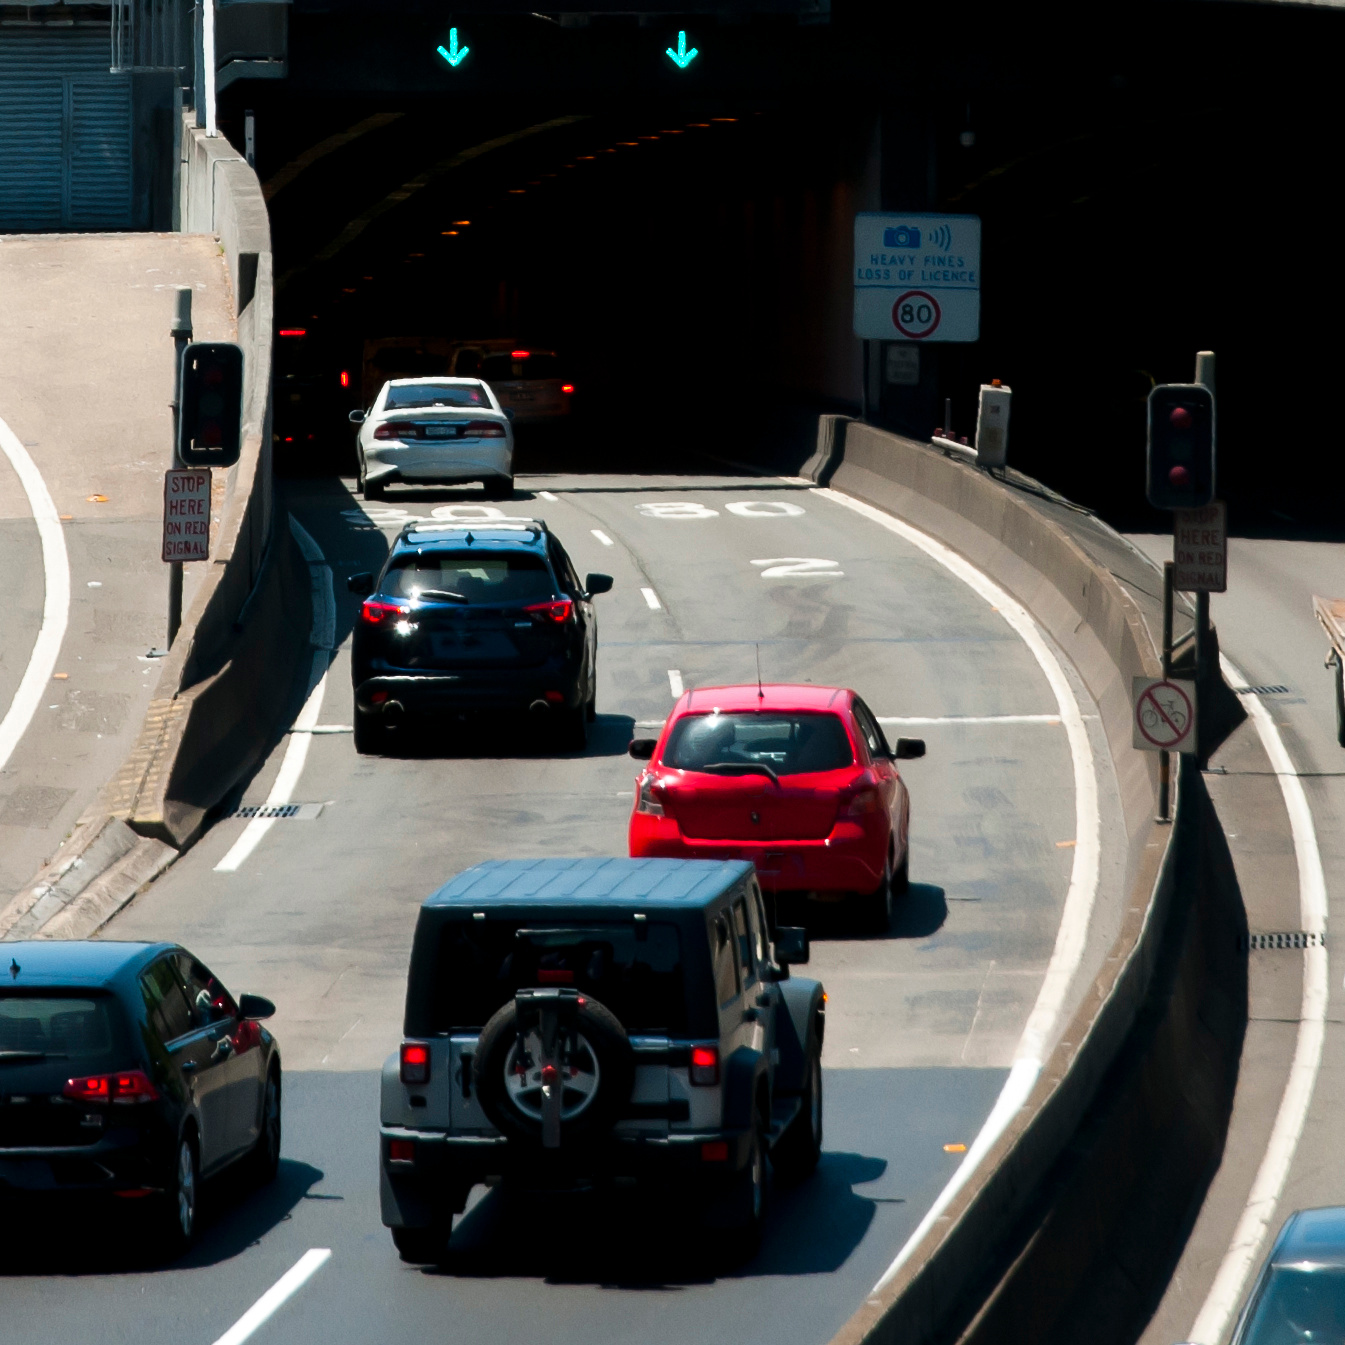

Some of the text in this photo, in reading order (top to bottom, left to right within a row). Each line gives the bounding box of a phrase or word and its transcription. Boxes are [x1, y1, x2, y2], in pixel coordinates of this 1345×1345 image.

[870, 254, 965, 267] HEAVY FINES
[857, 268, 976, 282] LOSS OF LICENCE
[900, 303, 933, 324] 80
[171, 476, 206, 493] STOP
[169, 499, 206, 516] HERE
[634, 501, 807, 519] 80
[166, 520, 207, 535] ON RED
[1179, 529, 1219, 545] HERE
[165, 540, 206, 556] SIGNAL
[1177, 550, 1224, 565] ON RED
[1177, 571, 1221, 586] SIGNAL
